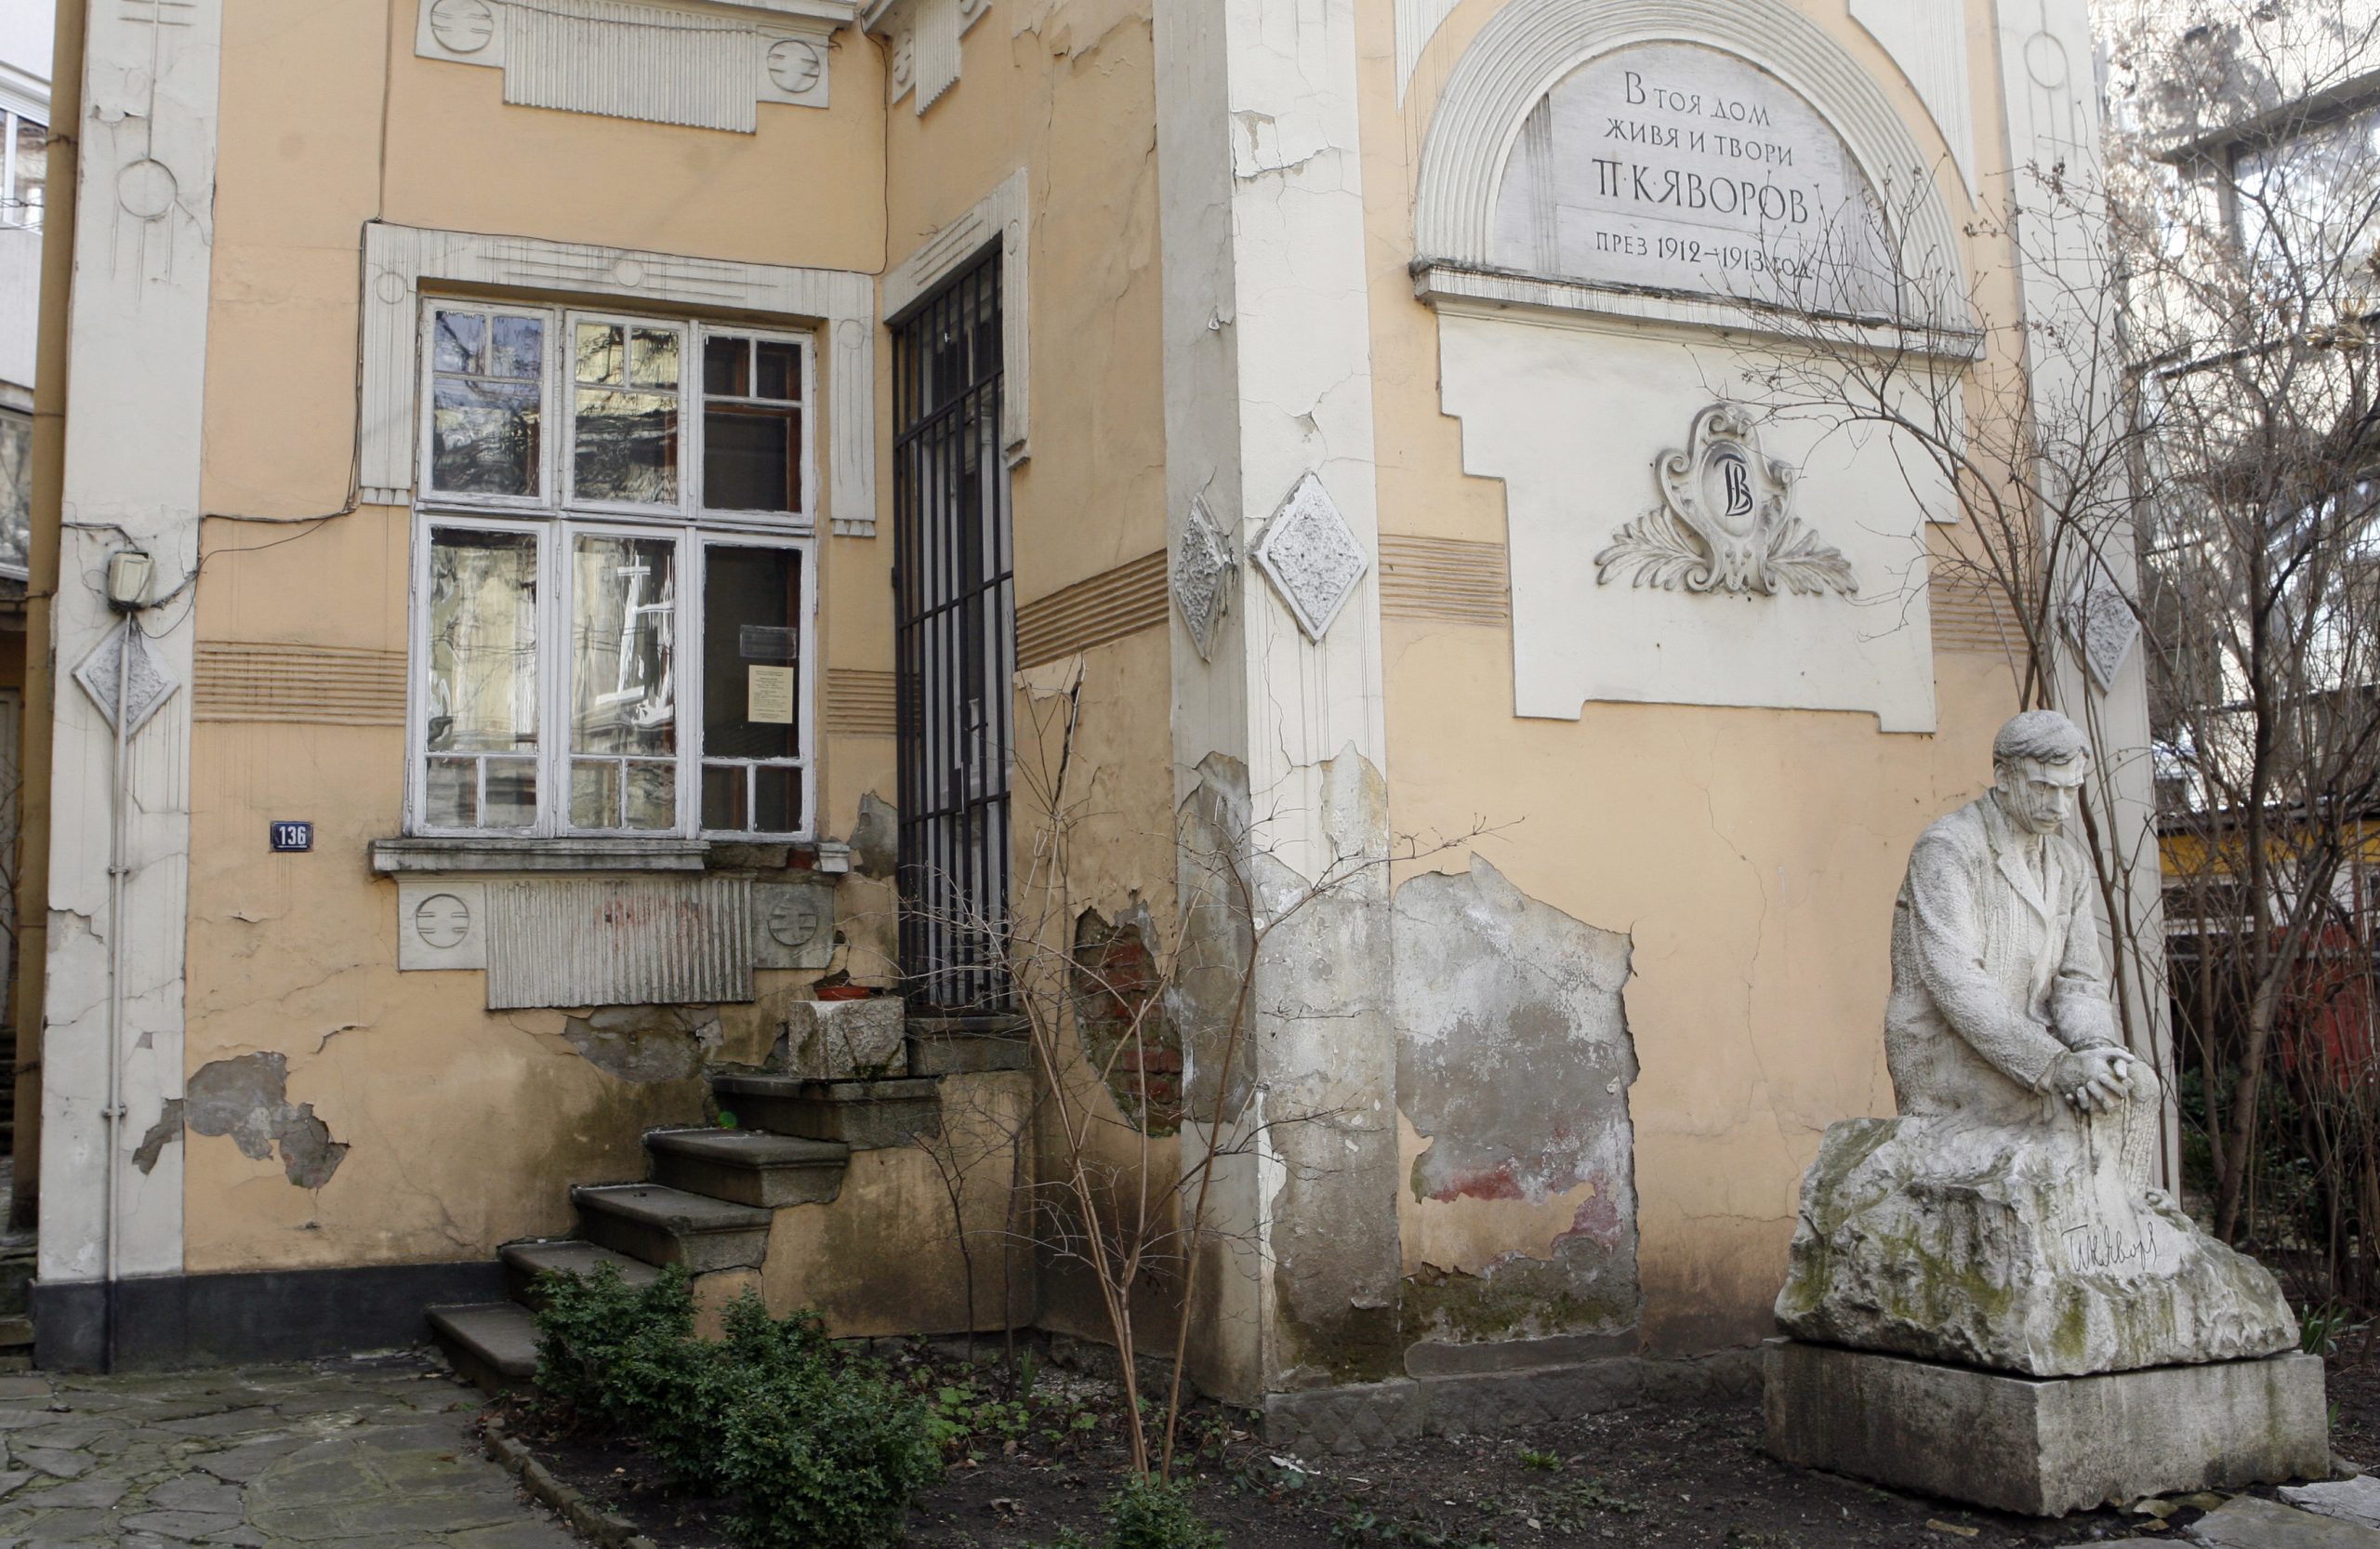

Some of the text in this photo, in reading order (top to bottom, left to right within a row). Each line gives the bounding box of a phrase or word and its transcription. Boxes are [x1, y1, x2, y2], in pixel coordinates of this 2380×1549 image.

[1624, 71, 1646, 105] В
[1605, 118, 1793, 167] ЖИВЯ И ТВОРИ
[1595, 232, 1648, 256] ПРЕЗ
[279, 826, 307, 845] 136
